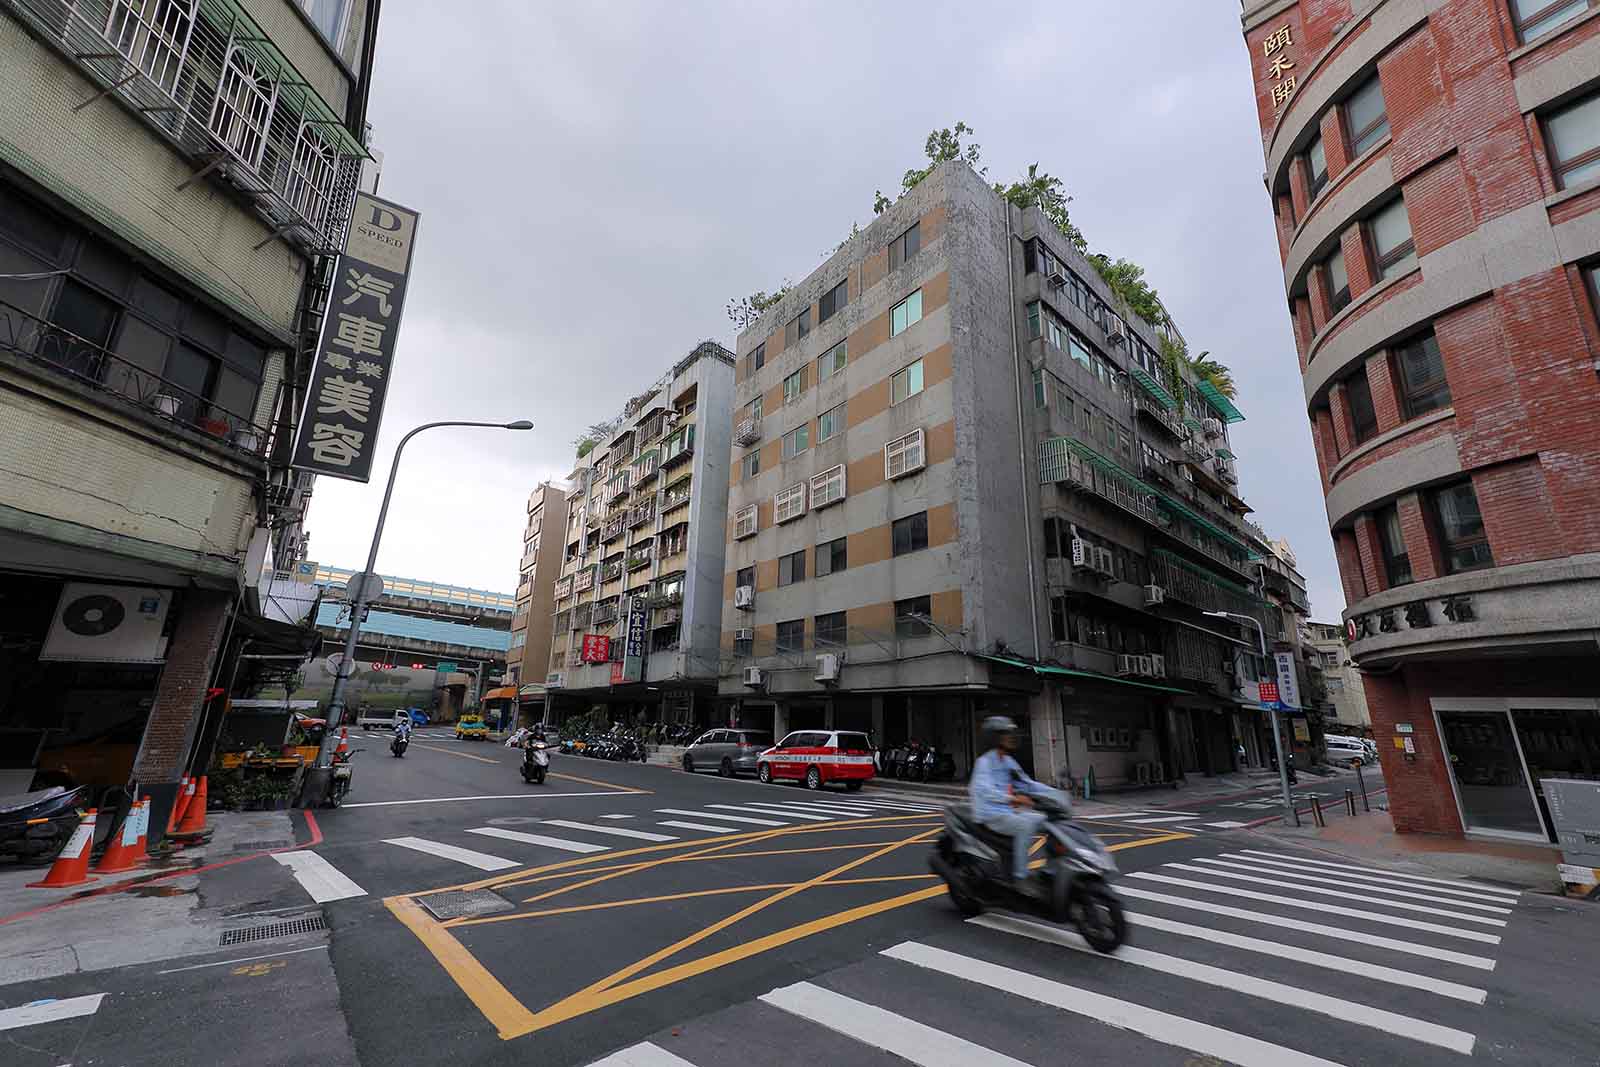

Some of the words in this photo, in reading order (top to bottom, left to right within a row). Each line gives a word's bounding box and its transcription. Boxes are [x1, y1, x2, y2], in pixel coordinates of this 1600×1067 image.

[1263, 24, 1297, 119] 頤禾開
[366, 204, 402, 232] D
[356, 223, 403, 249] SPEED
